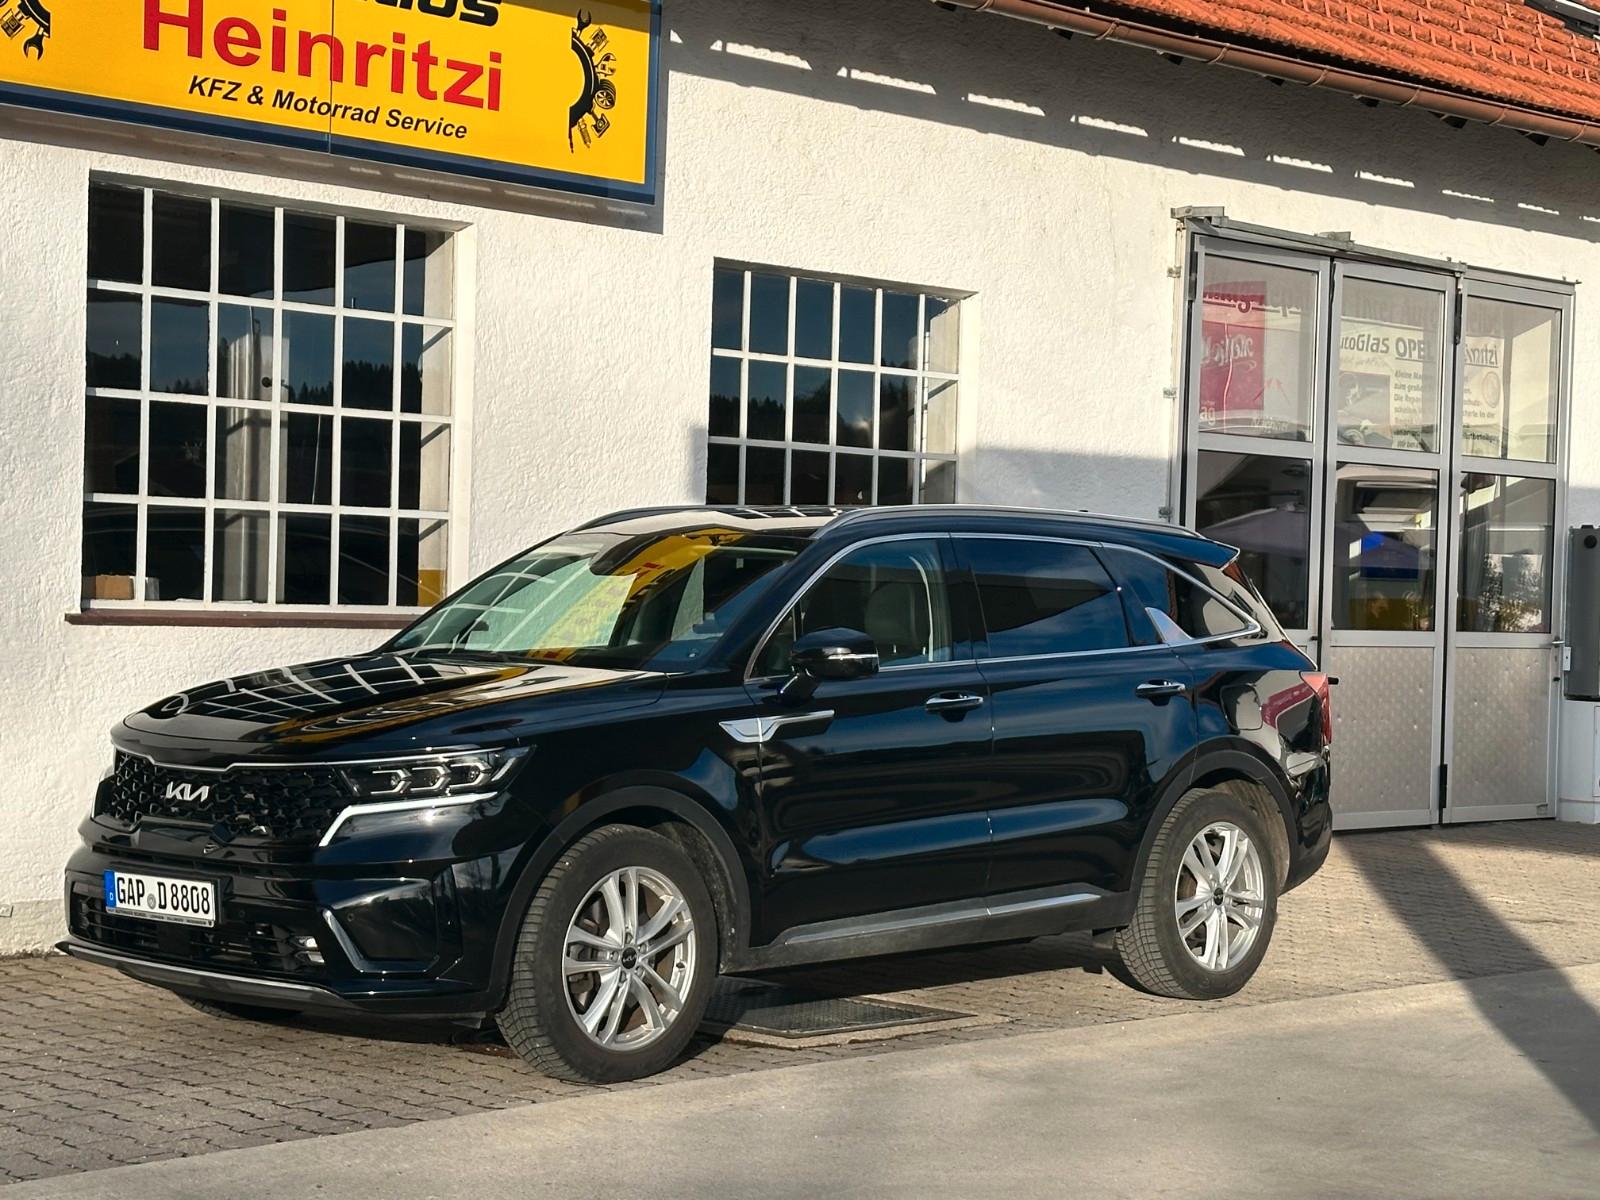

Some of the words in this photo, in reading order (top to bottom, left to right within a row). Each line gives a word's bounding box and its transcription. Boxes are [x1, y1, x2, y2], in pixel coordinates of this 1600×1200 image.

[143, 0, 502, 112] Heinritzi
[188, 75, 242, 102] KFZ
[247, 85, 264, 105] &
[271, 89, 380, 124] Motorrad
[385, 109, 467, 139] Service
[116, 877, 146, 907] GAP
